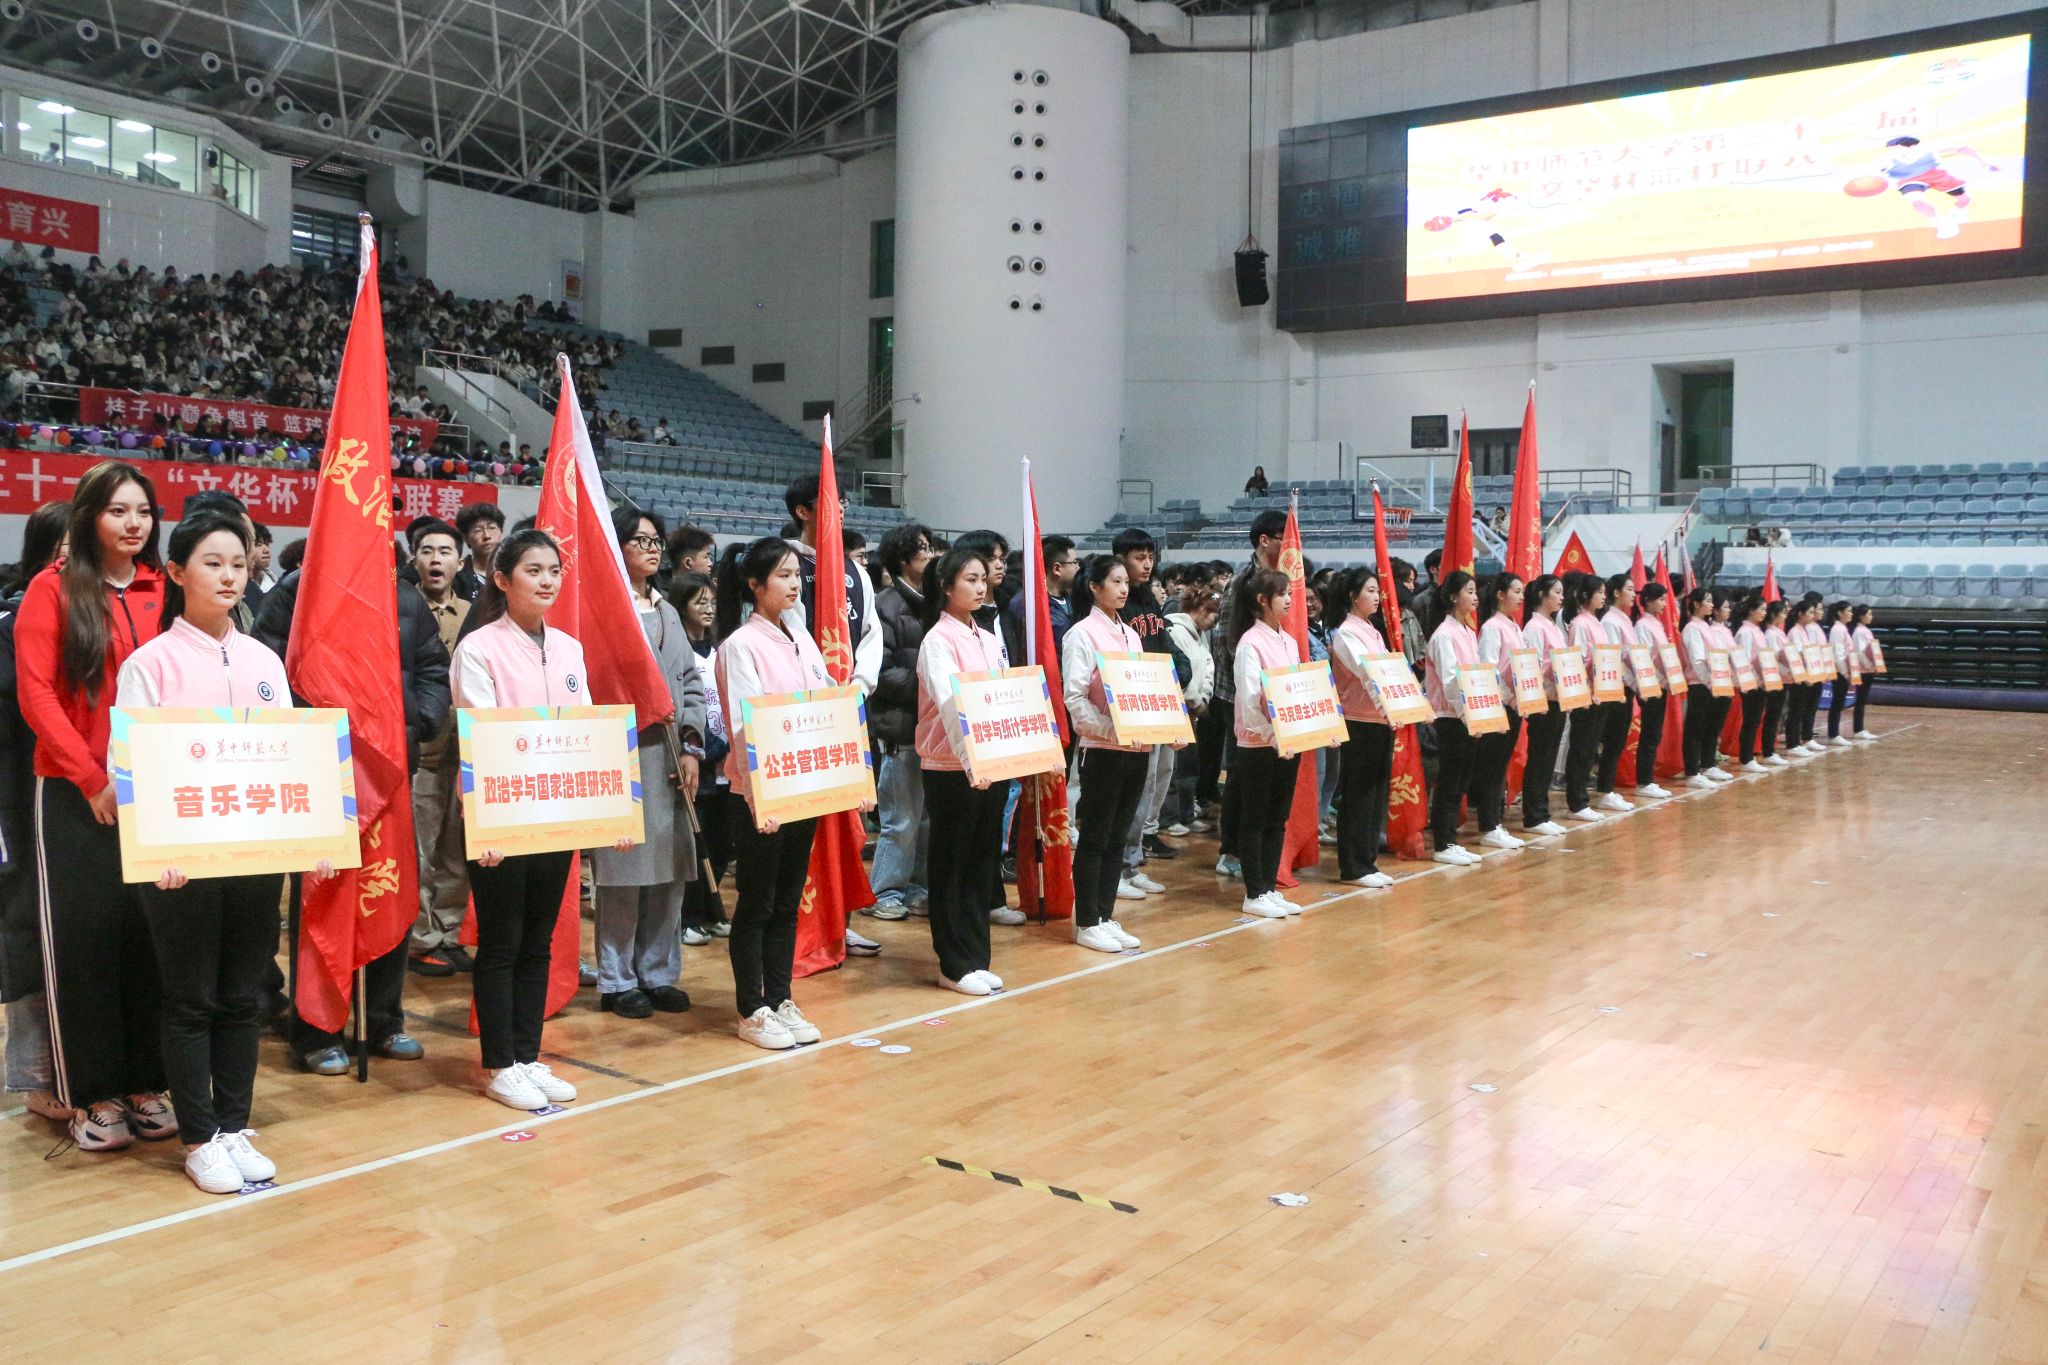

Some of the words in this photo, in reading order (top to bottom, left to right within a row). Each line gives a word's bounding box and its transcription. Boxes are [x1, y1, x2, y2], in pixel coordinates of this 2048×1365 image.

[0, 201, 71, 239] 育兴
[1117, 693, 1180, 712] 新闻传播学院
[1278, 698, 1335, 723] 马克思主义学院
[972, 713, 1049, 744] 数学与统计学学院
[764, 742, 860, 779] 公共管理学院
[174, 783, 311, 818] 音乐学院
[484, 769, 624, 804] 政治学与国家治理研究院
